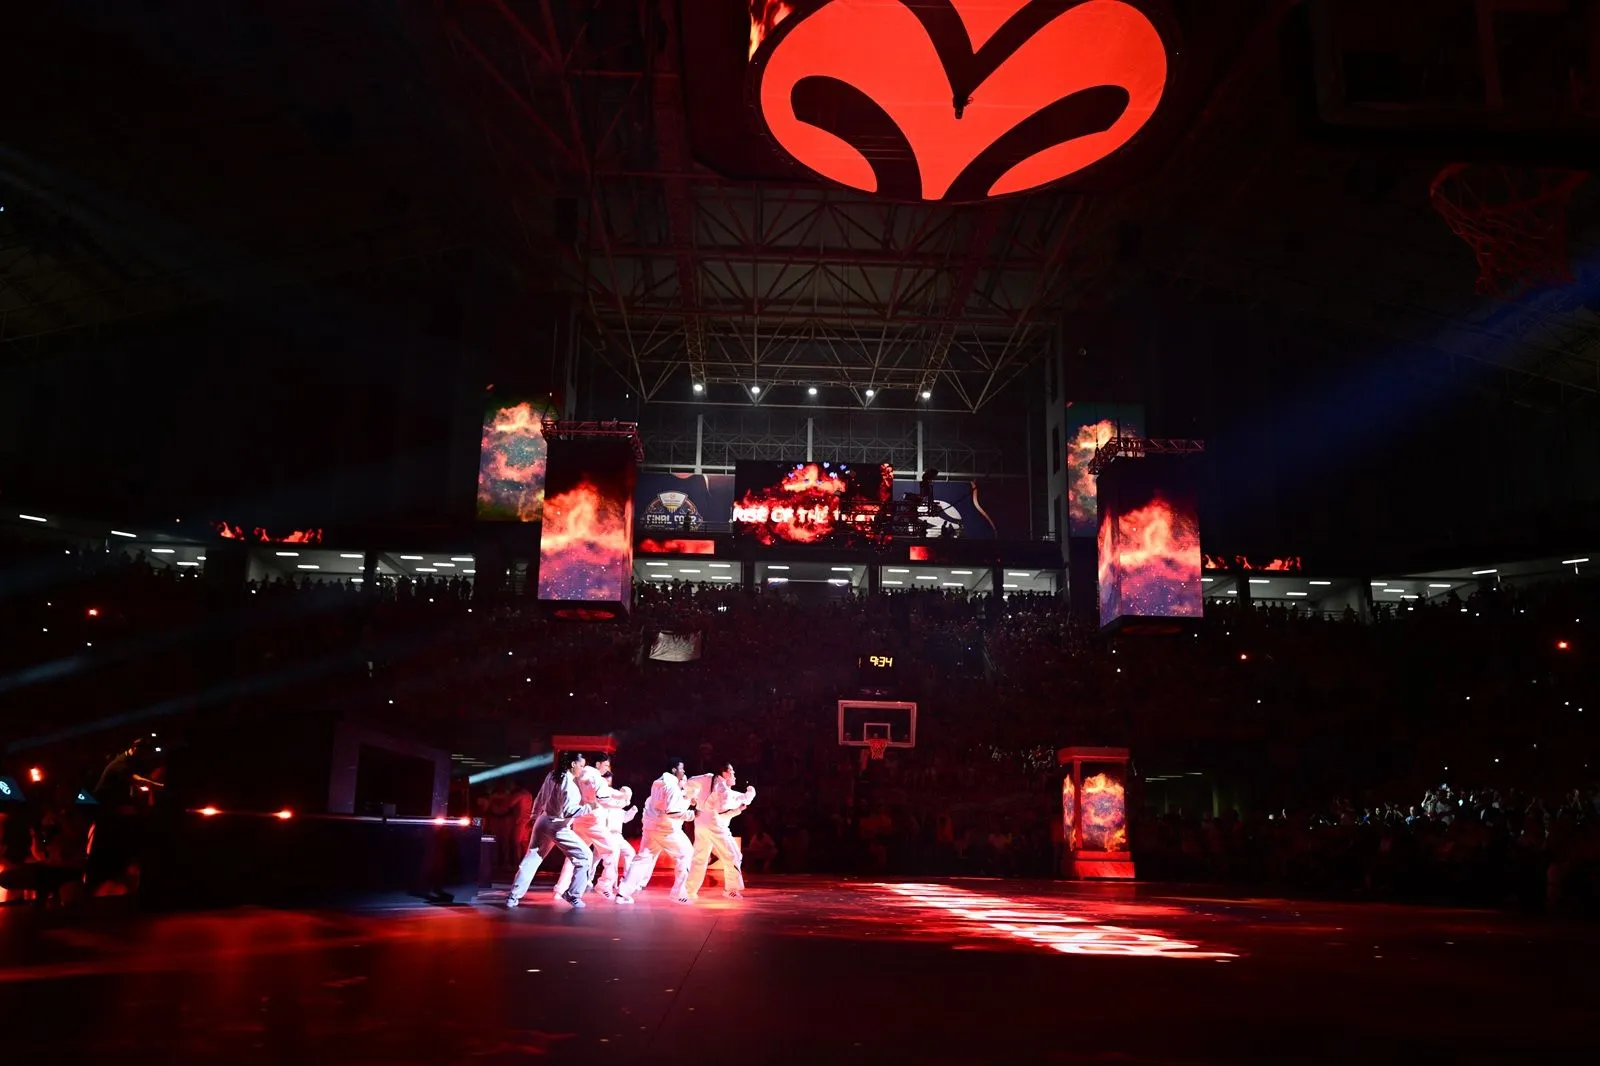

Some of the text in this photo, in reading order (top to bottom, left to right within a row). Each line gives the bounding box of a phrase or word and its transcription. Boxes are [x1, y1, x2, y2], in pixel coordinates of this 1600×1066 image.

[646, 514, 697, 525] FINAL FOR
[733, 506, 768, 522] RISE
[771, 507, 794, 522] OF
[870, 656, 893, 667] 9:34
